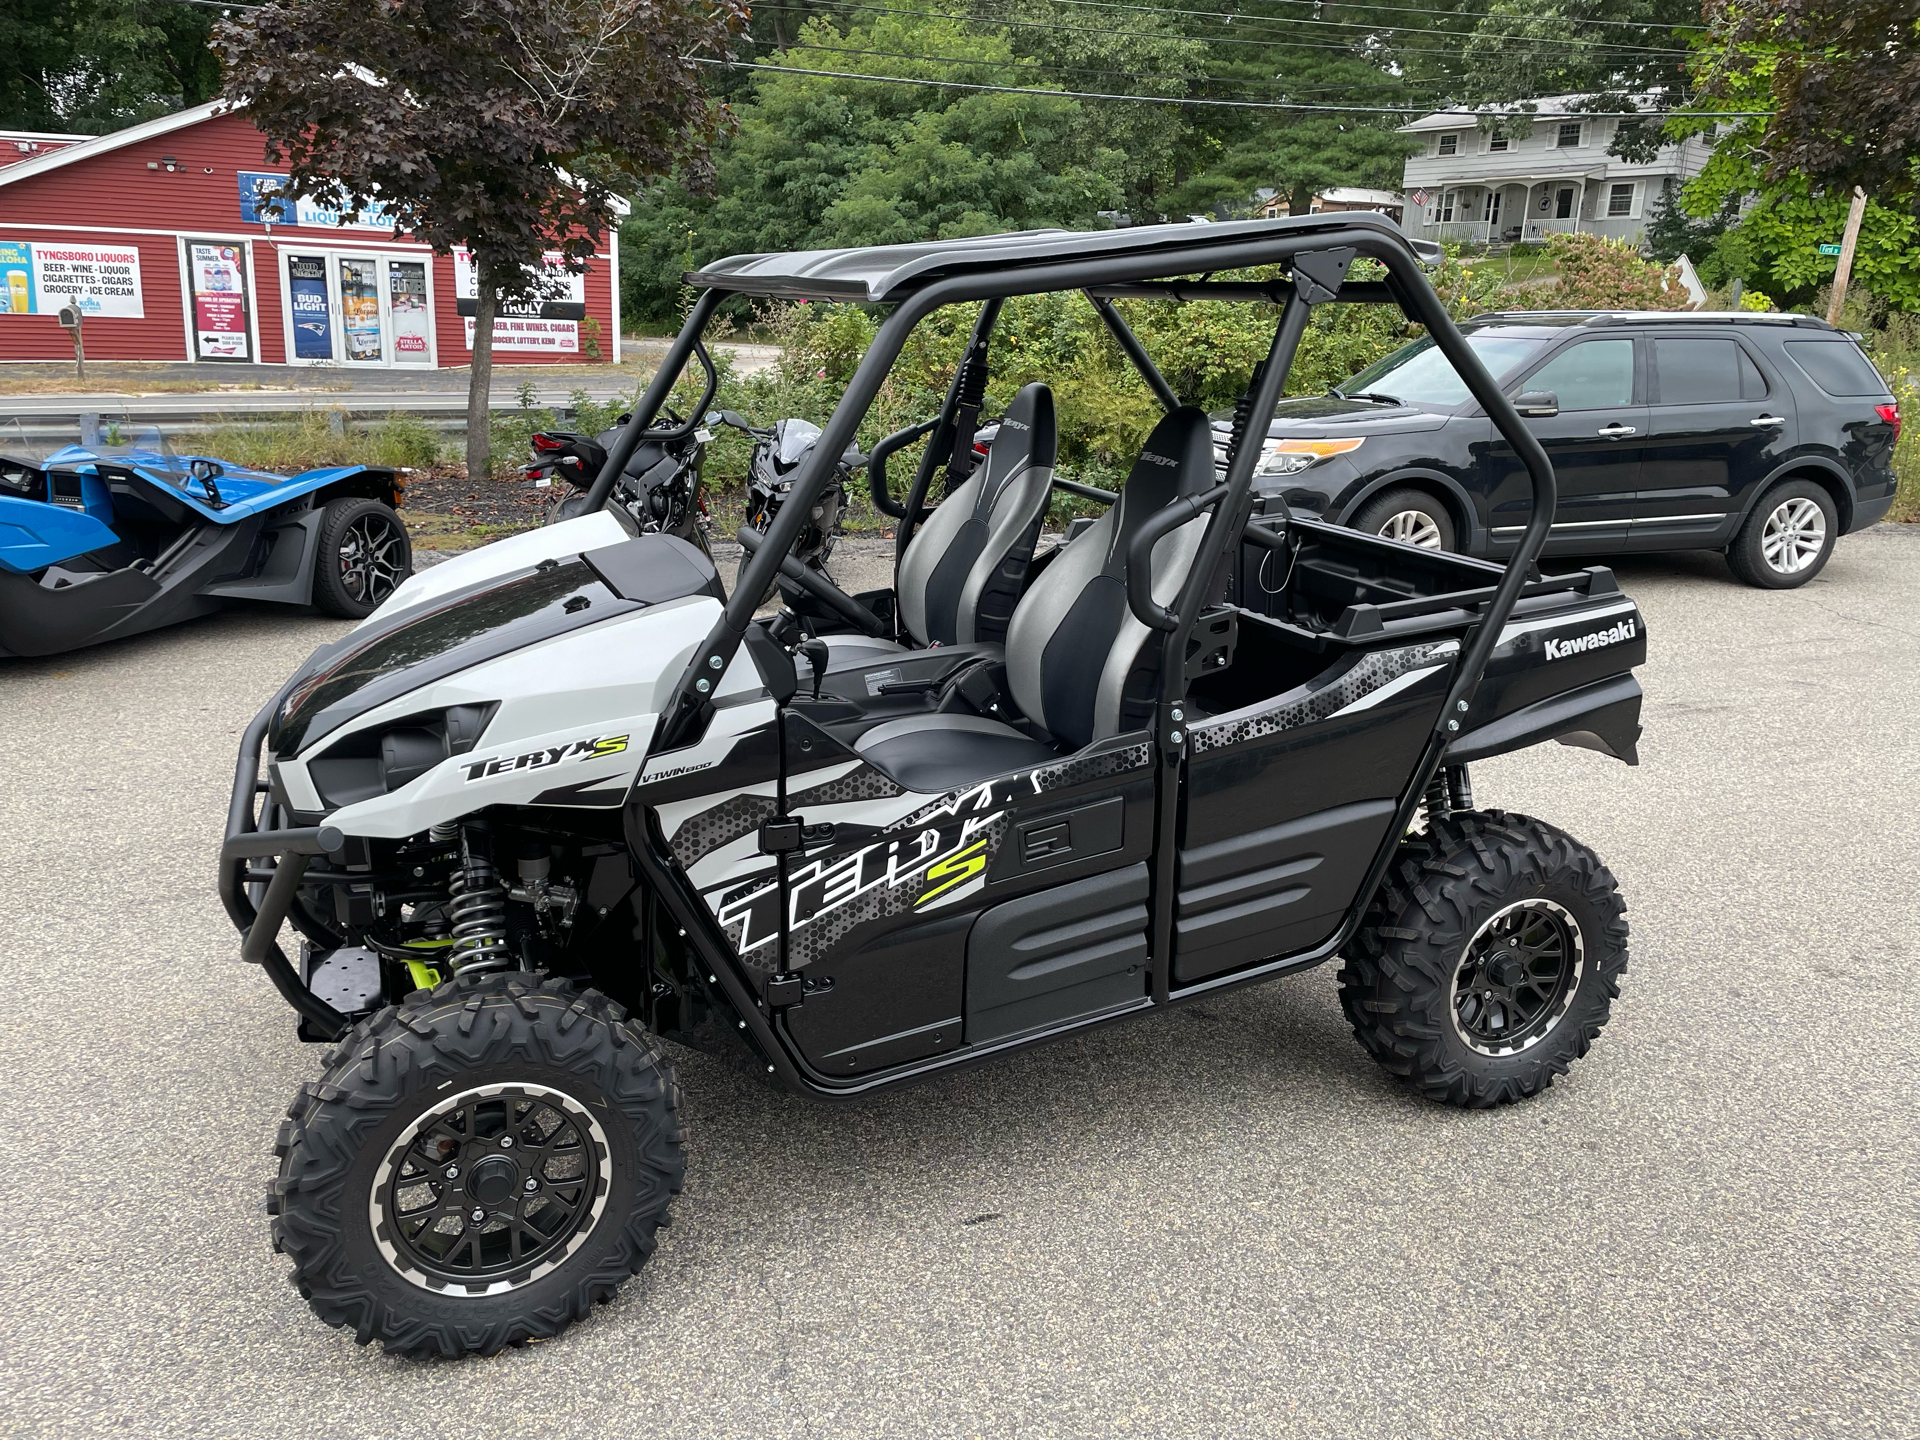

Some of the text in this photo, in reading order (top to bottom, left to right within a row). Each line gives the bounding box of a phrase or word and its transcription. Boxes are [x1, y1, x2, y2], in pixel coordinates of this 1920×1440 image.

[36, 250, 136, 263] TYNGSBORO LIQUORS
[195, 247, 211, 255] TASTE
[43, 263, 131, 275] BEER WINE LIQUOR
[42, 273, 134, 286] CIGARETTES CIGARS
[43, 284, 135, 297] GROCERY ICE CREAM
[297, 294, 322, 303] BUD
[293, 302, 328, 311] LIGHT
[510, 322, 525, 331] FINE
[525, 322, 550, 332] WINES,
[550, 323, 575, 332] CIGARS
[1543, 618, 1637, 661] Kawasaki
